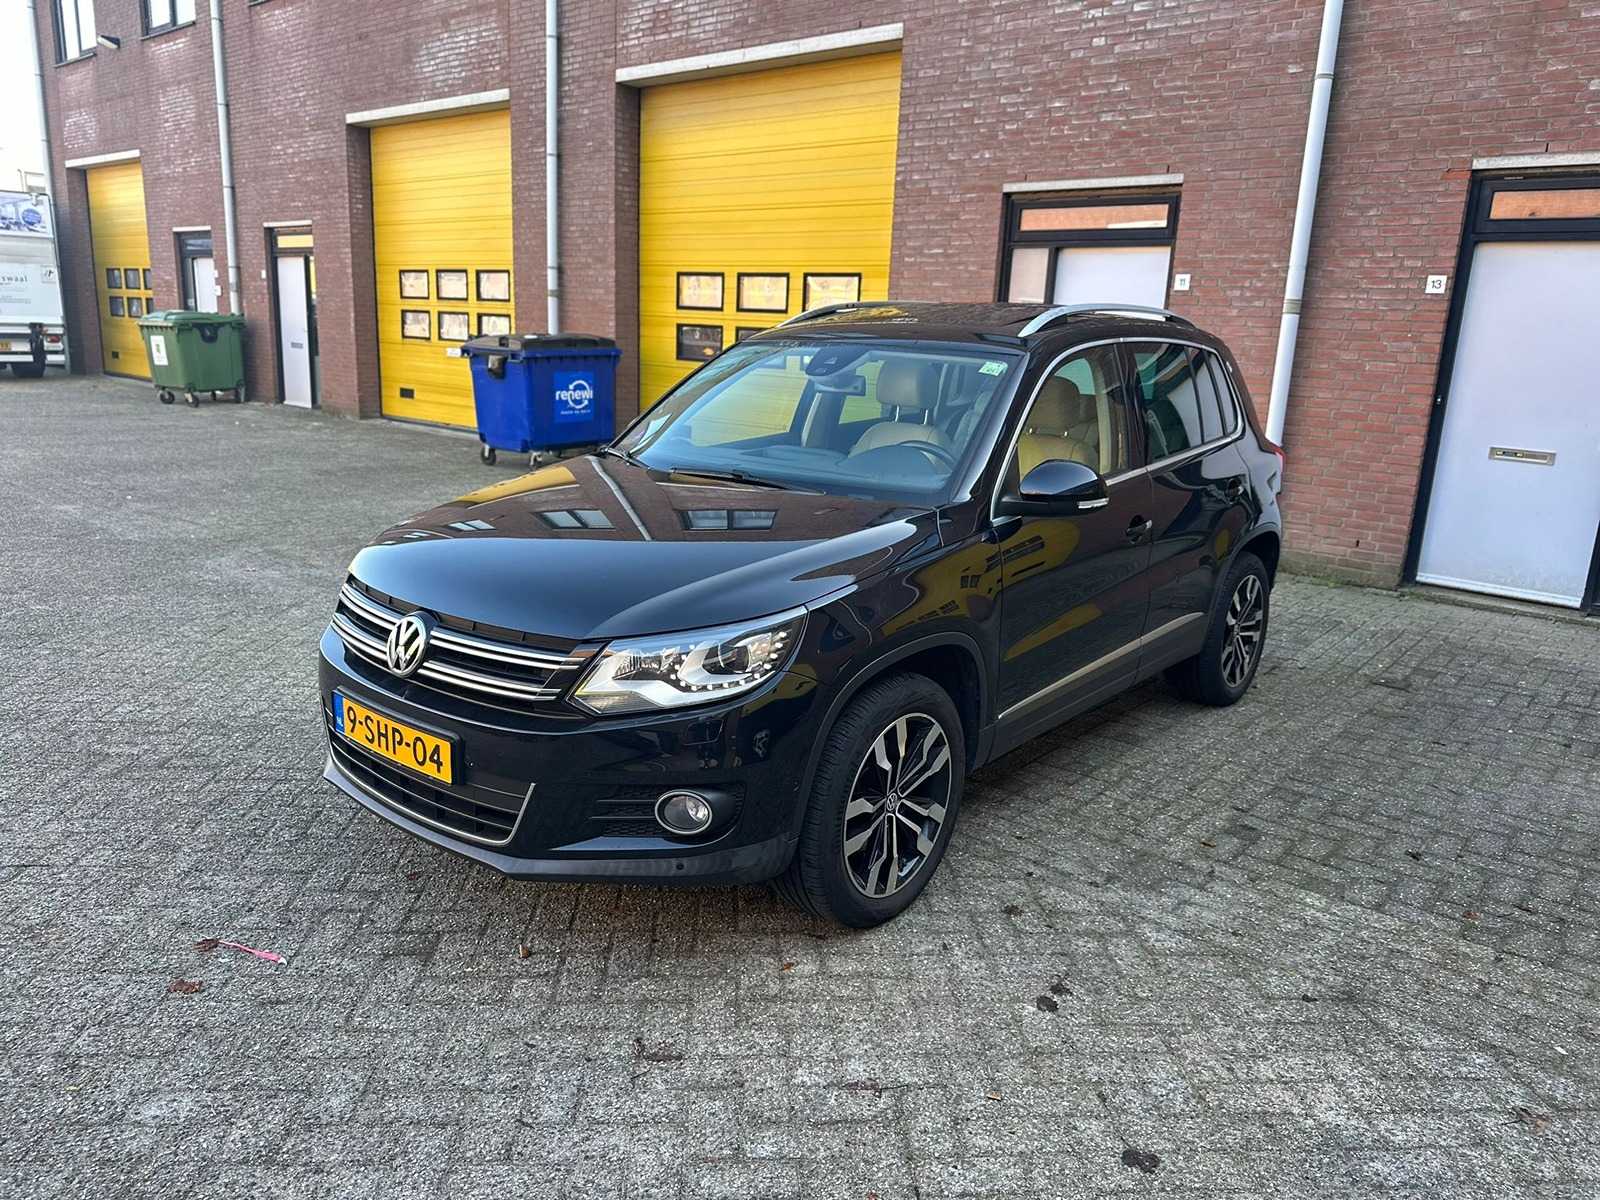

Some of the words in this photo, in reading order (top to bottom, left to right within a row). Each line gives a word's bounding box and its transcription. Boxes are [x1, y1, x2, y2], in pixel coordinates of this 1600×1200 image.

[1431, 279, 1442, 289] 13
[555, 387, 593, 401] renewi
[346, 706, 444, 774] 9-SHP-04
